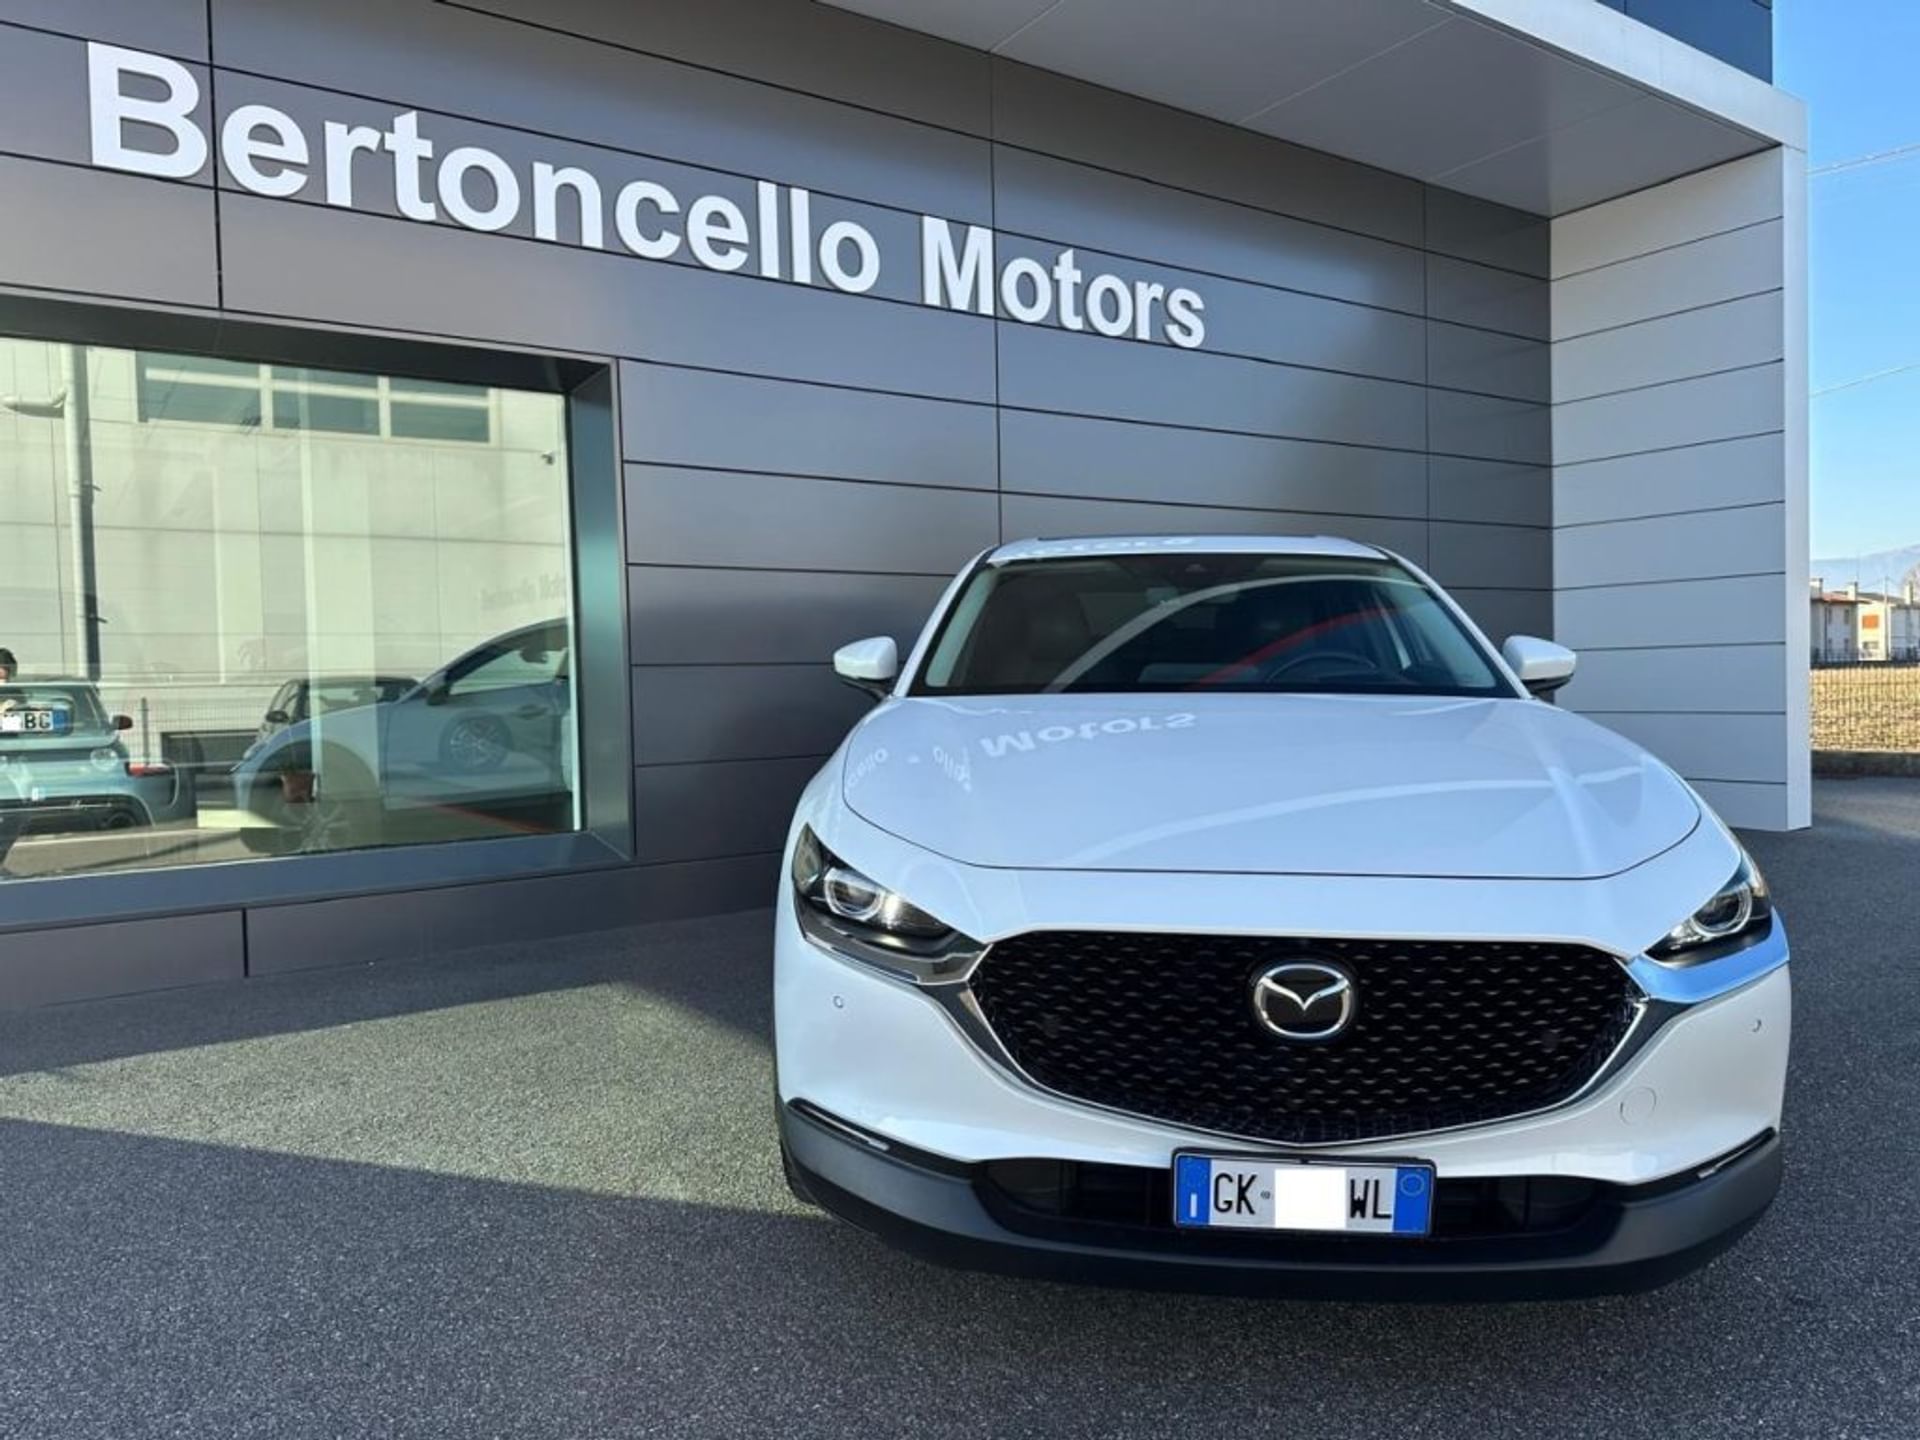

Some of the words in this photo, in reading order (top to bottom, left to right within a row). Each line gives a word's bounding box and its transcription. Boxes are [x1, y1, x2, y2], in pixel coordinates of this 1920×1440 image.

[88, 41, 880, 294] Bertoncello
[921, 215, 1205, 348] Motors
[1214, 1173, 1257, 1215] GK
[1350, 1179, 1392, 1219] WL
